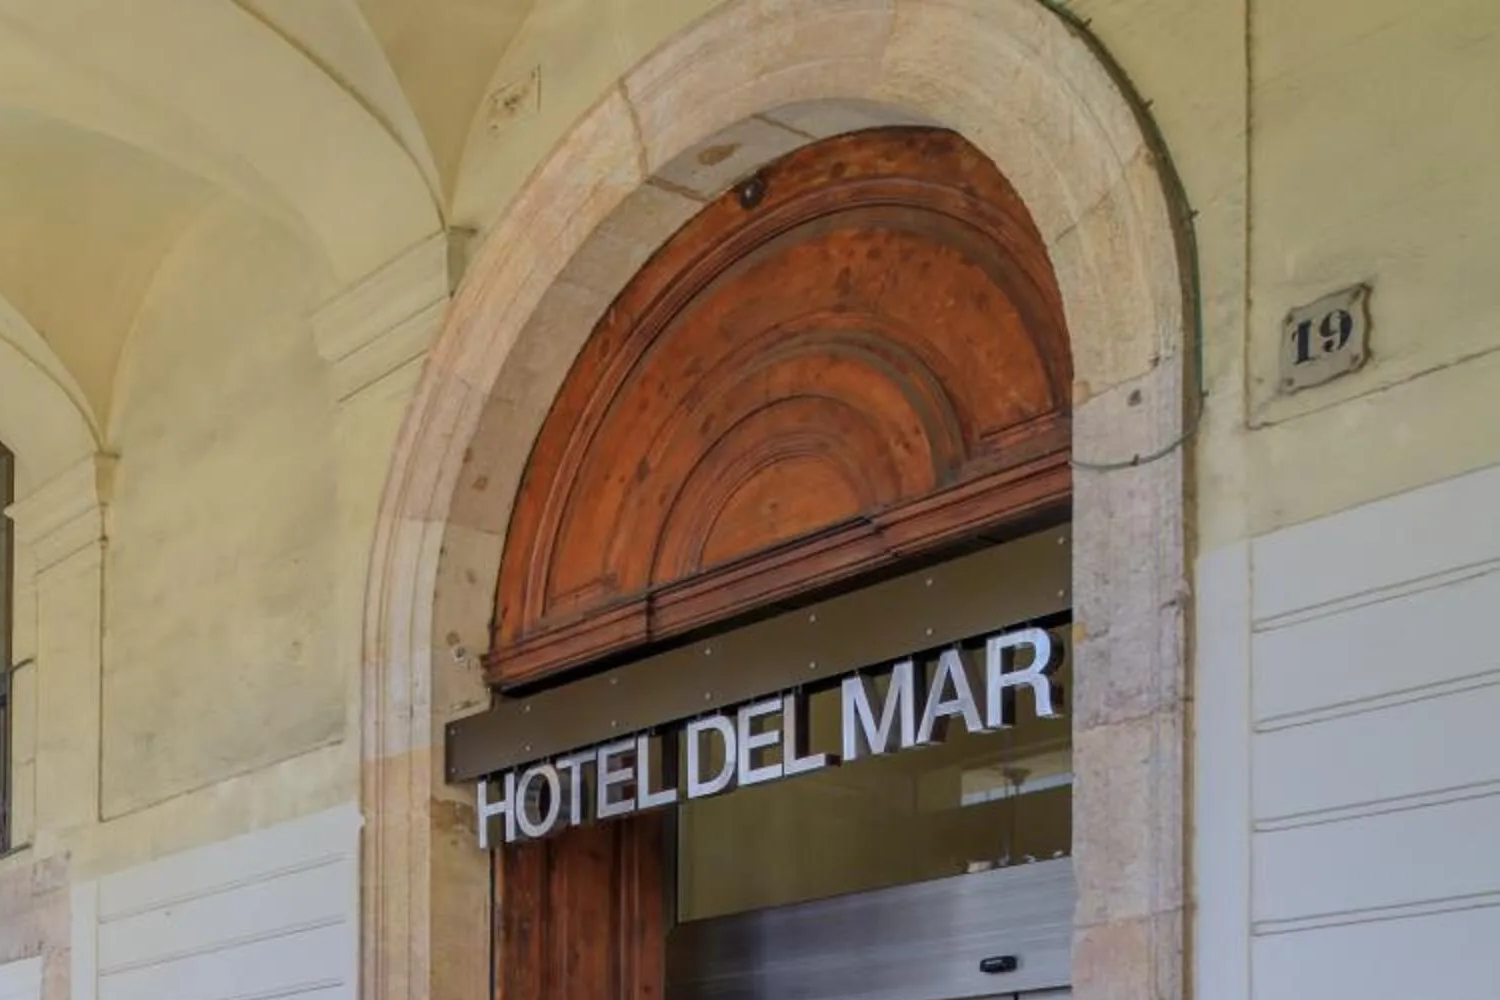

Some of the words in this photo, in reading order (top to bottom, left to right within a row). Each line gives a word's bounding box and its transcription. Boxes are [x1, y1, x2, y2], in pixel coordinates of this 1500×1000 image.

[1291, 309, 1353, 366] 19
[476, 734, 677, 849] HOTEL
[687, 693, 826, 799] DEL
[841, 627, 1053, 761] MAR
